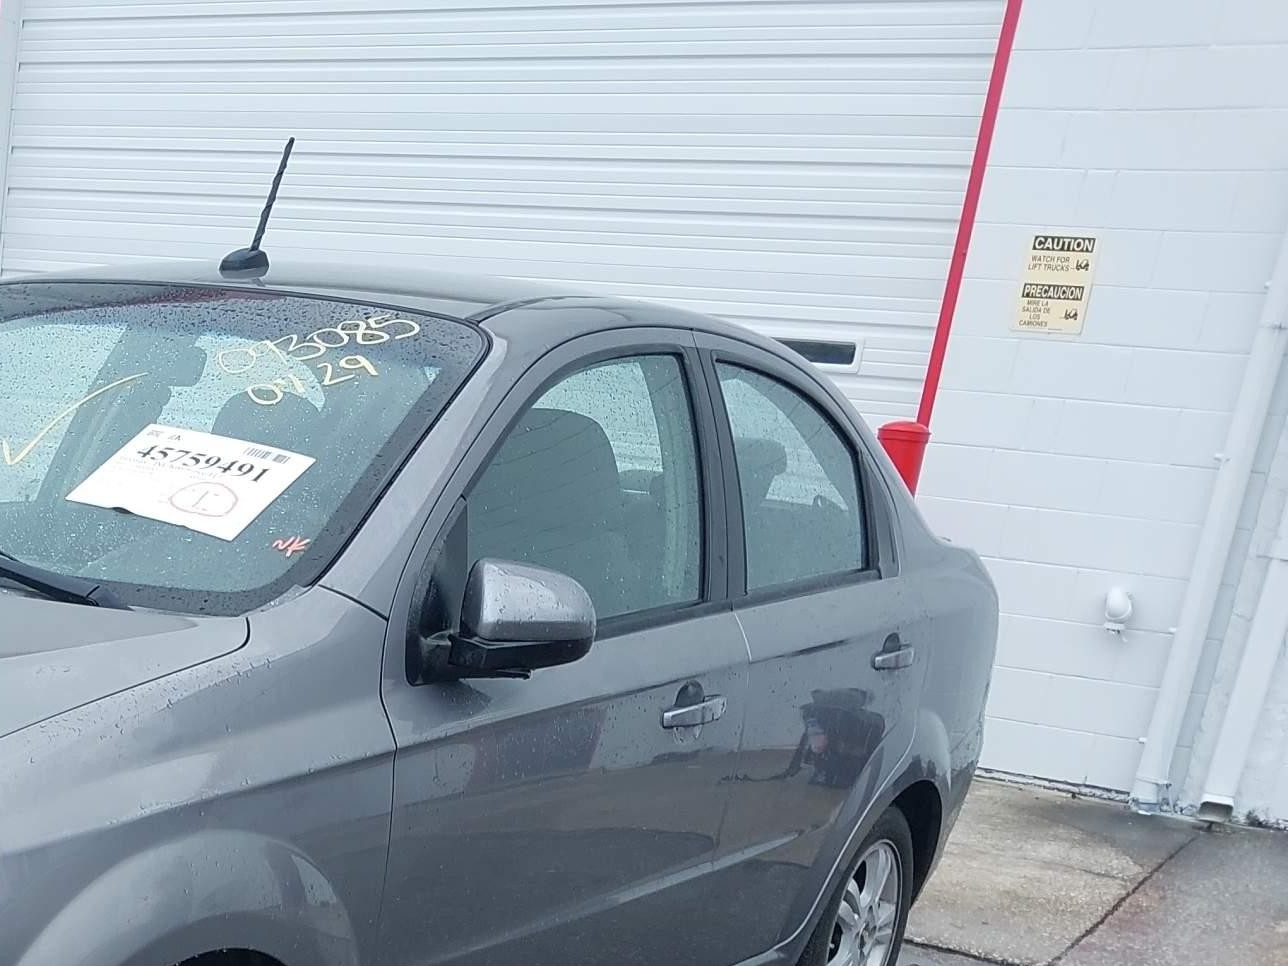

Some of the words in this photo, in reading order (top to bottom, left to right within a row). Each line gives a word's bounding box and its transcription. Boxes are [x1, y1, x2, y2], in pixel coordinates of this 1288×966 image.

[1034, 237, 1094, 251] CAUTION
[1032, 255, 1055, 263] WATCH
[1043, 264, 1070, 272] TRUCKS
[1023, 284, 1083, 299] PRECAUCION
[136, 444, 272, 483] 45759491
